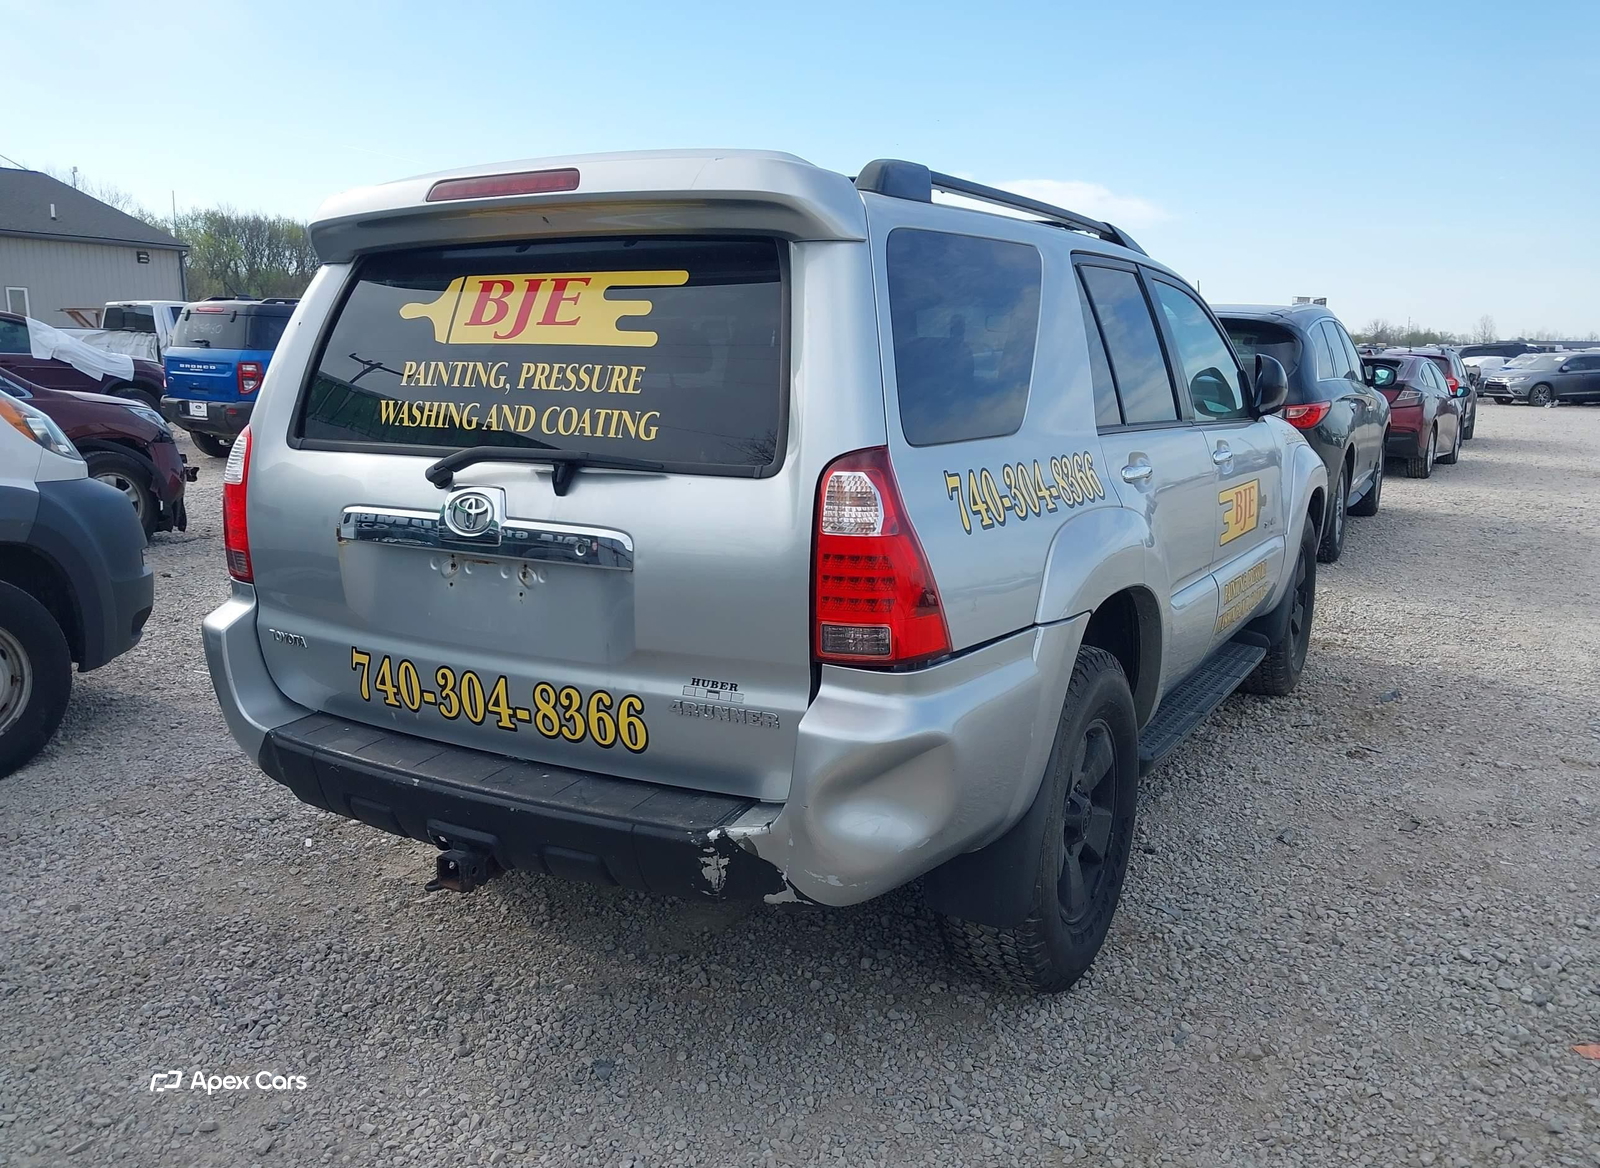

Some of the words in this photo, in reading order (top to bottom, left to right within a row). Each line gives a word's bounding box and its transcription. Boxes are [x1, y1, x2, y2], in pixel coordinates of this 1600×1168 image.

[464, 277, 592, 340] BJE
[179, 362, 216, 370] BRONCO
[400, 360, 511, 394] PAINTING,
[517, 362, 646, 395] PRESSURE
[380, 400, 480, 430] WASHING
[482, 403, 537, 433] AND
[541, 406, 660, 441] COATING
[943, 450, 1106, 535] 740-304-8366
[1234, 486, 1255, 531] BJE
[268, 628, 308, 649] TOYOTA
[351, 646, 649, 754] 740-304-8366
[690, 677, 739, 692] HUBER
[669, 699, 780, 729] 4RUNNER
